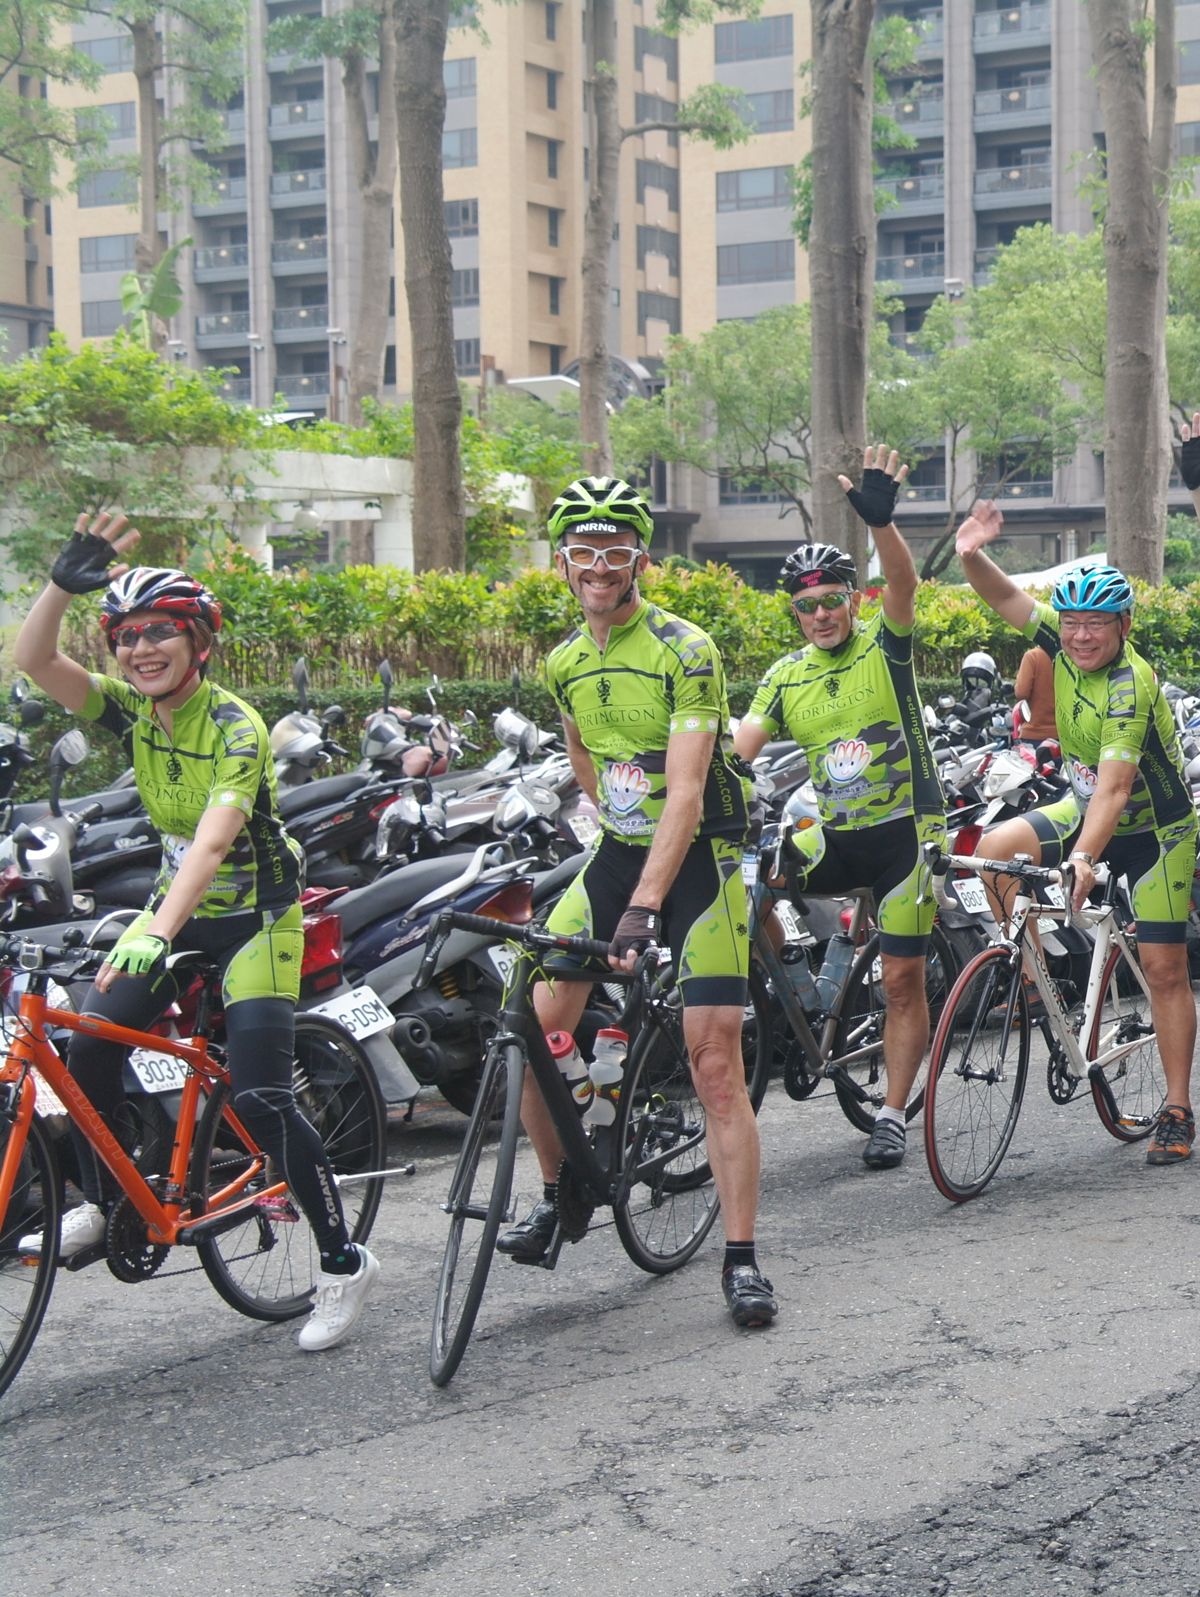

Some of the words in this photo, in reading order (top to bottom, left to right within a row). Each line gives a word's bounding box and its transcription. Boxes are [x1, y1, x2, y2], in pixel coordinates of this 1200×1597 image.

[576, 523, 617, 533] INRNG
[795, 686, 875, 721] EDRINGTON
[906, 695, 930, 779] edrington.com
[315, 1164, 336, 1214] GIANT
